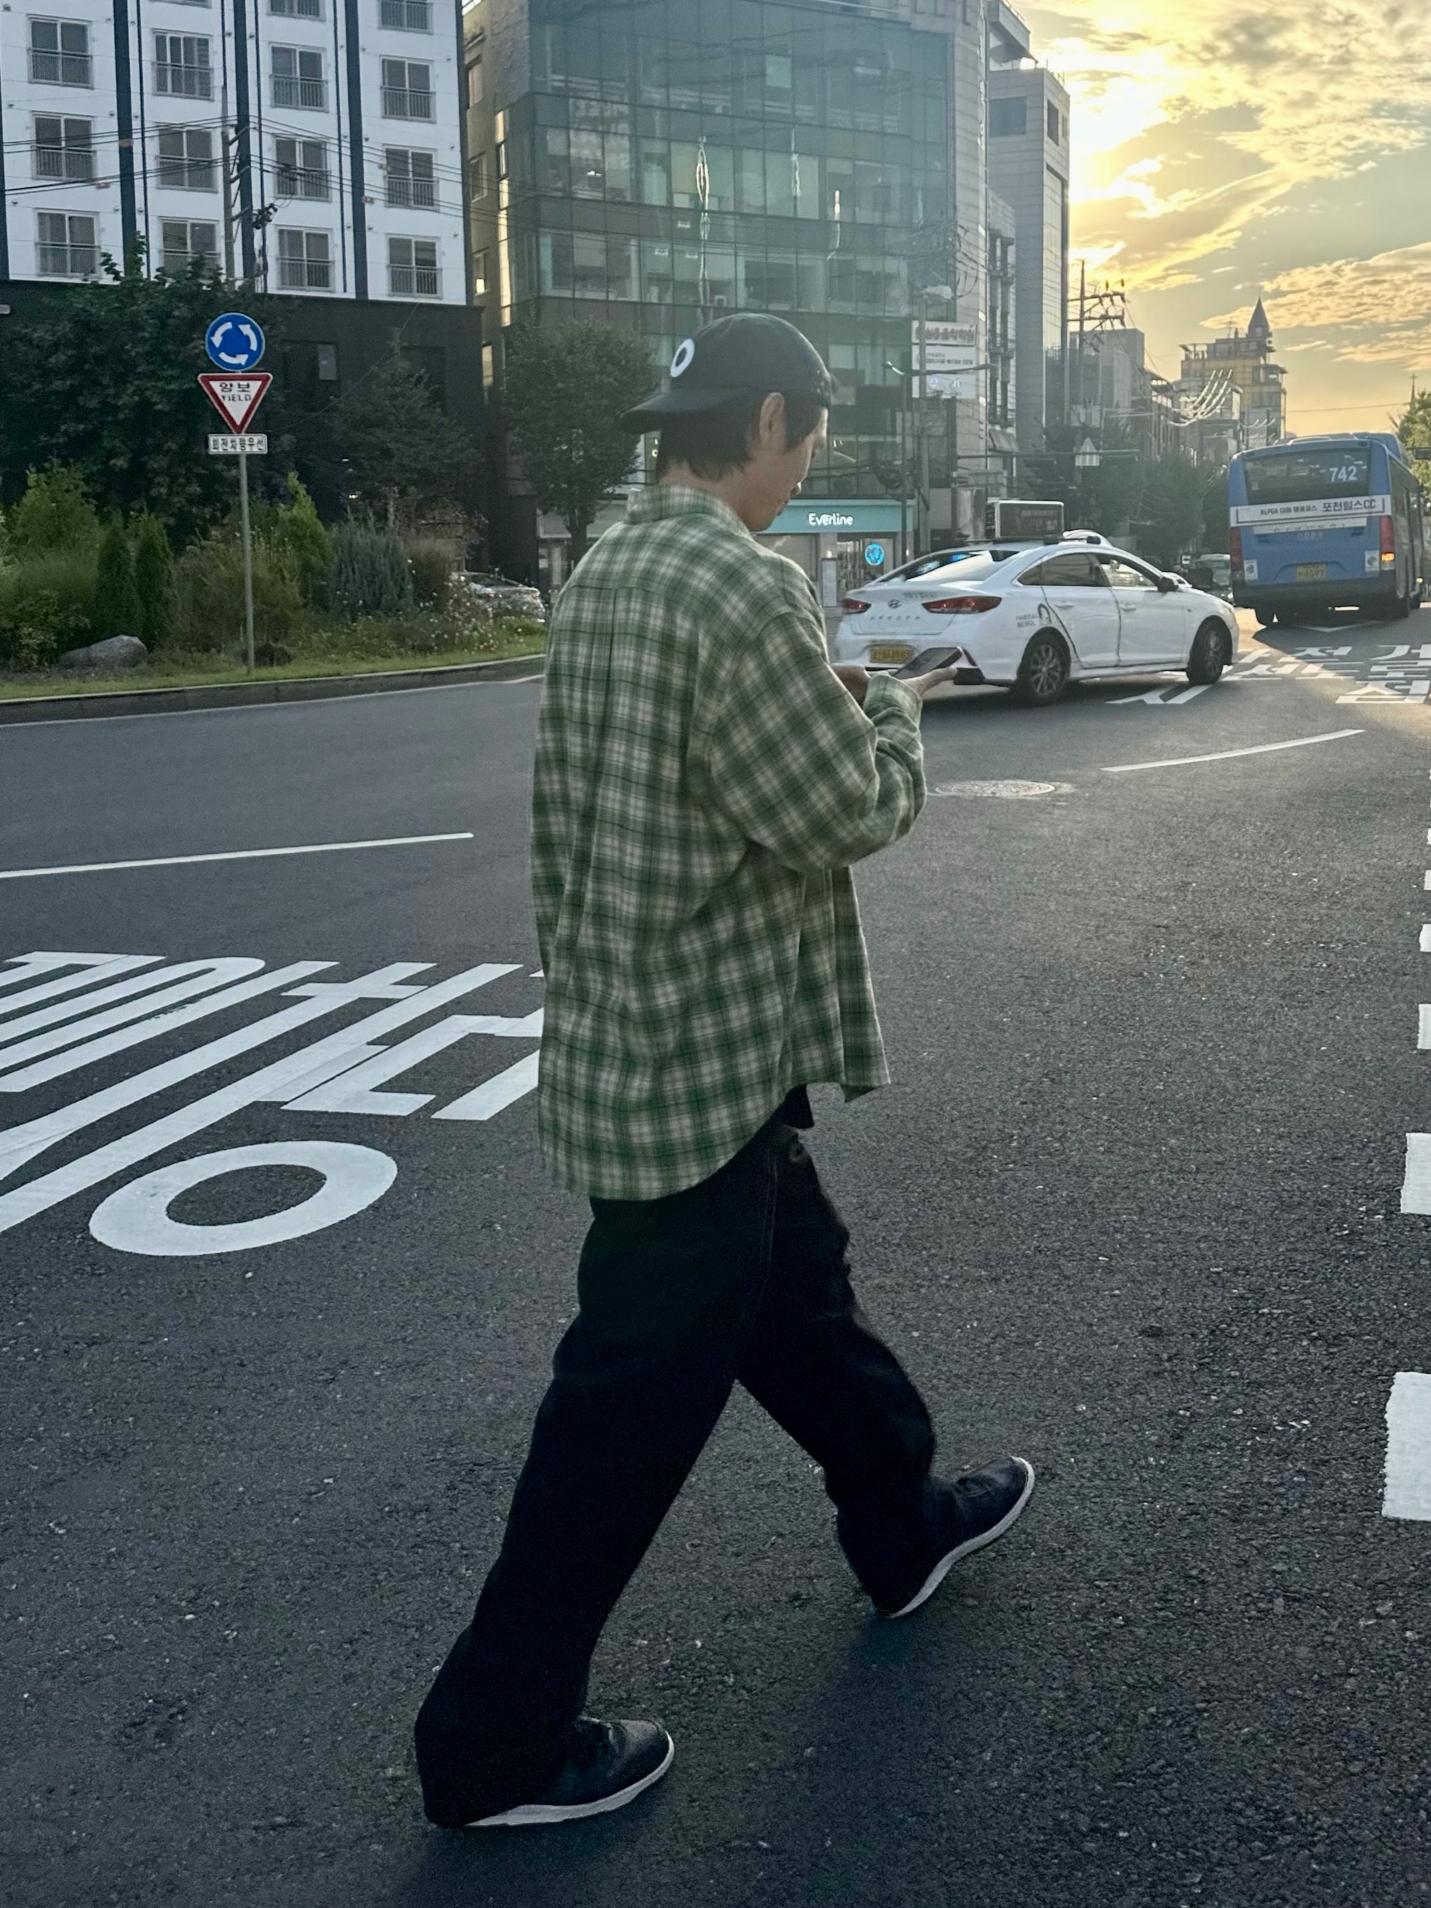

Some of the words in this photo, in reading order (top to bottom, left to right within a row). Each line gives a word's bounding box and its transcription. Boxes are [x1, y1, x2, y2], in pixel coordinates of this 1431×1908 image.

[219, 382, 250, 393] 양보
[221, 394, 252, 402] YIELD
[1329, 465, 1358, 483] 742
[1260, 508, 1279, 516] KLPGA
[1322, 499, 1377, 513] 포천힐스CC
[808, 513, 854, 525] Everline
